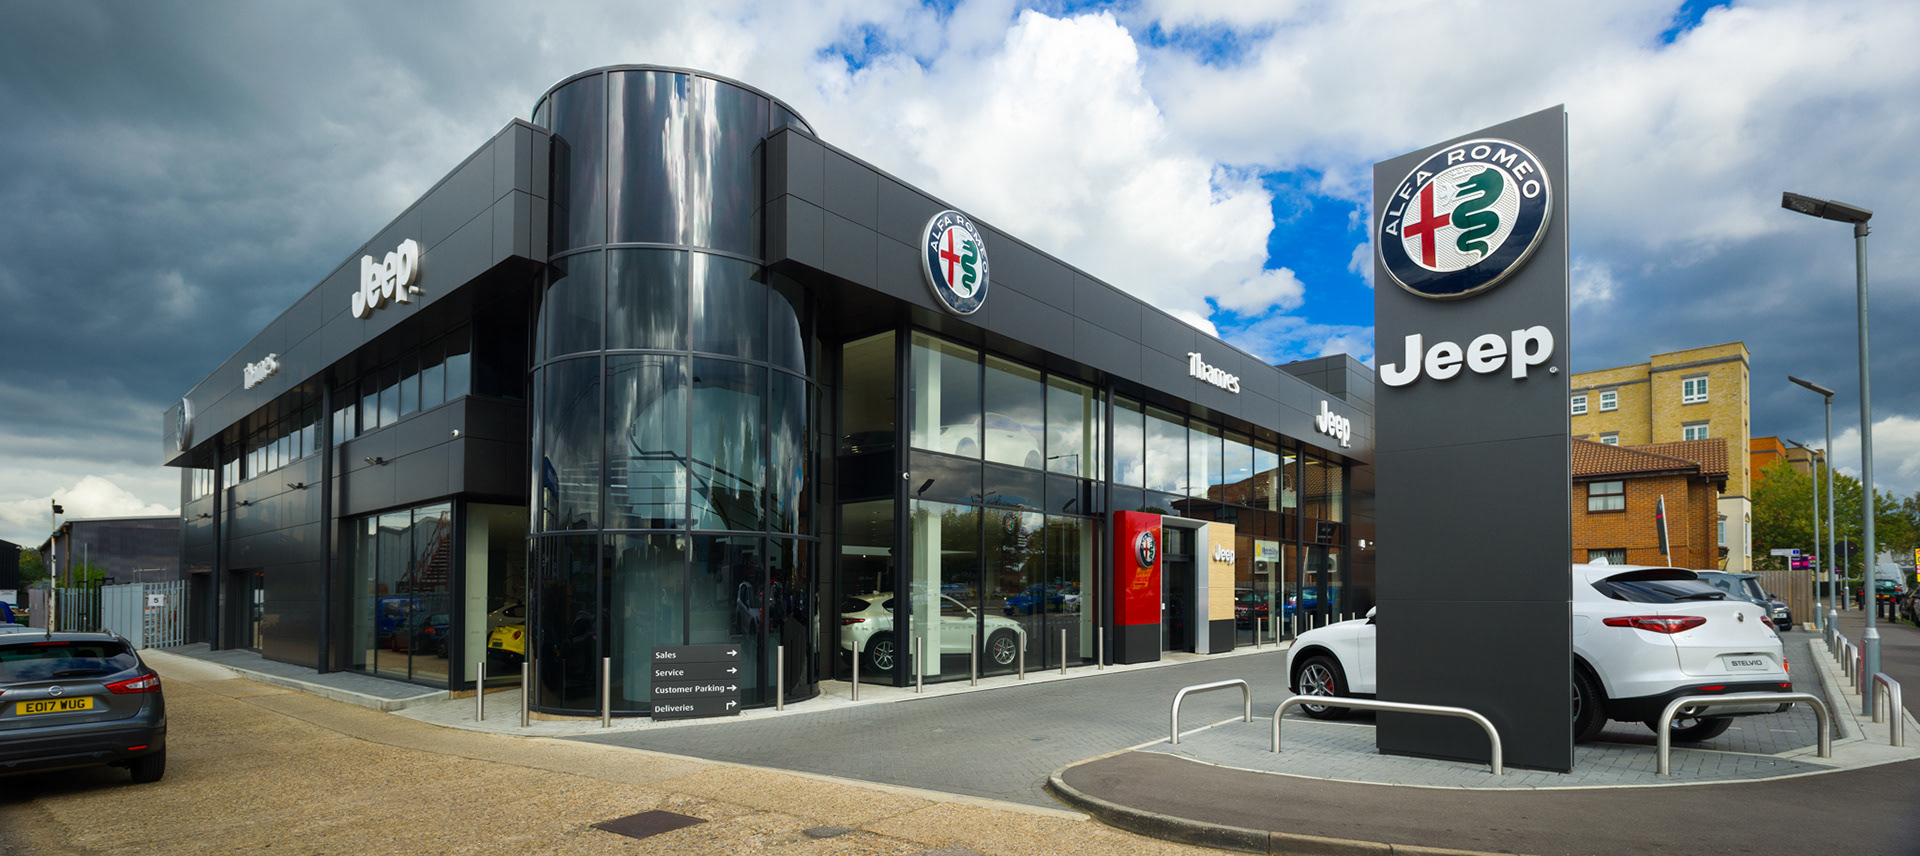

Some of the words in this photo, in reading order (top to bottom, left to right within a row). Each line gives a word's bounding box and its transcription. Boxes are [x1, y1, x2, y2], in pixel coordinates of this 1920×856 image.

[1385, 170, 1433, 236] ALFA
[1447, 144, 1541, 199] ROMEO
[930, 216, 952, 252] ALFA
[956, 215, 987, 273] ROMEO
[352, 238, 418, 318] Jeep
[1379, 325, 1555, 387] Jeep
[1187, 351, 1240, 394] Thames
[1315, 400, 1350, 448] Jeep
[1213, 544, 1234, 565] Jeep
[655, 651, 676, 659] Sales
[1731, 659, 1763, 667] STELVIO
[655, 669, 684, 677] Service
[655, 686, 693, 694] Customer
[694, 684, 725, 693] Parking
[60, 699, 85, 710] WUG
[654, 704, 694, 713] Deliveries
